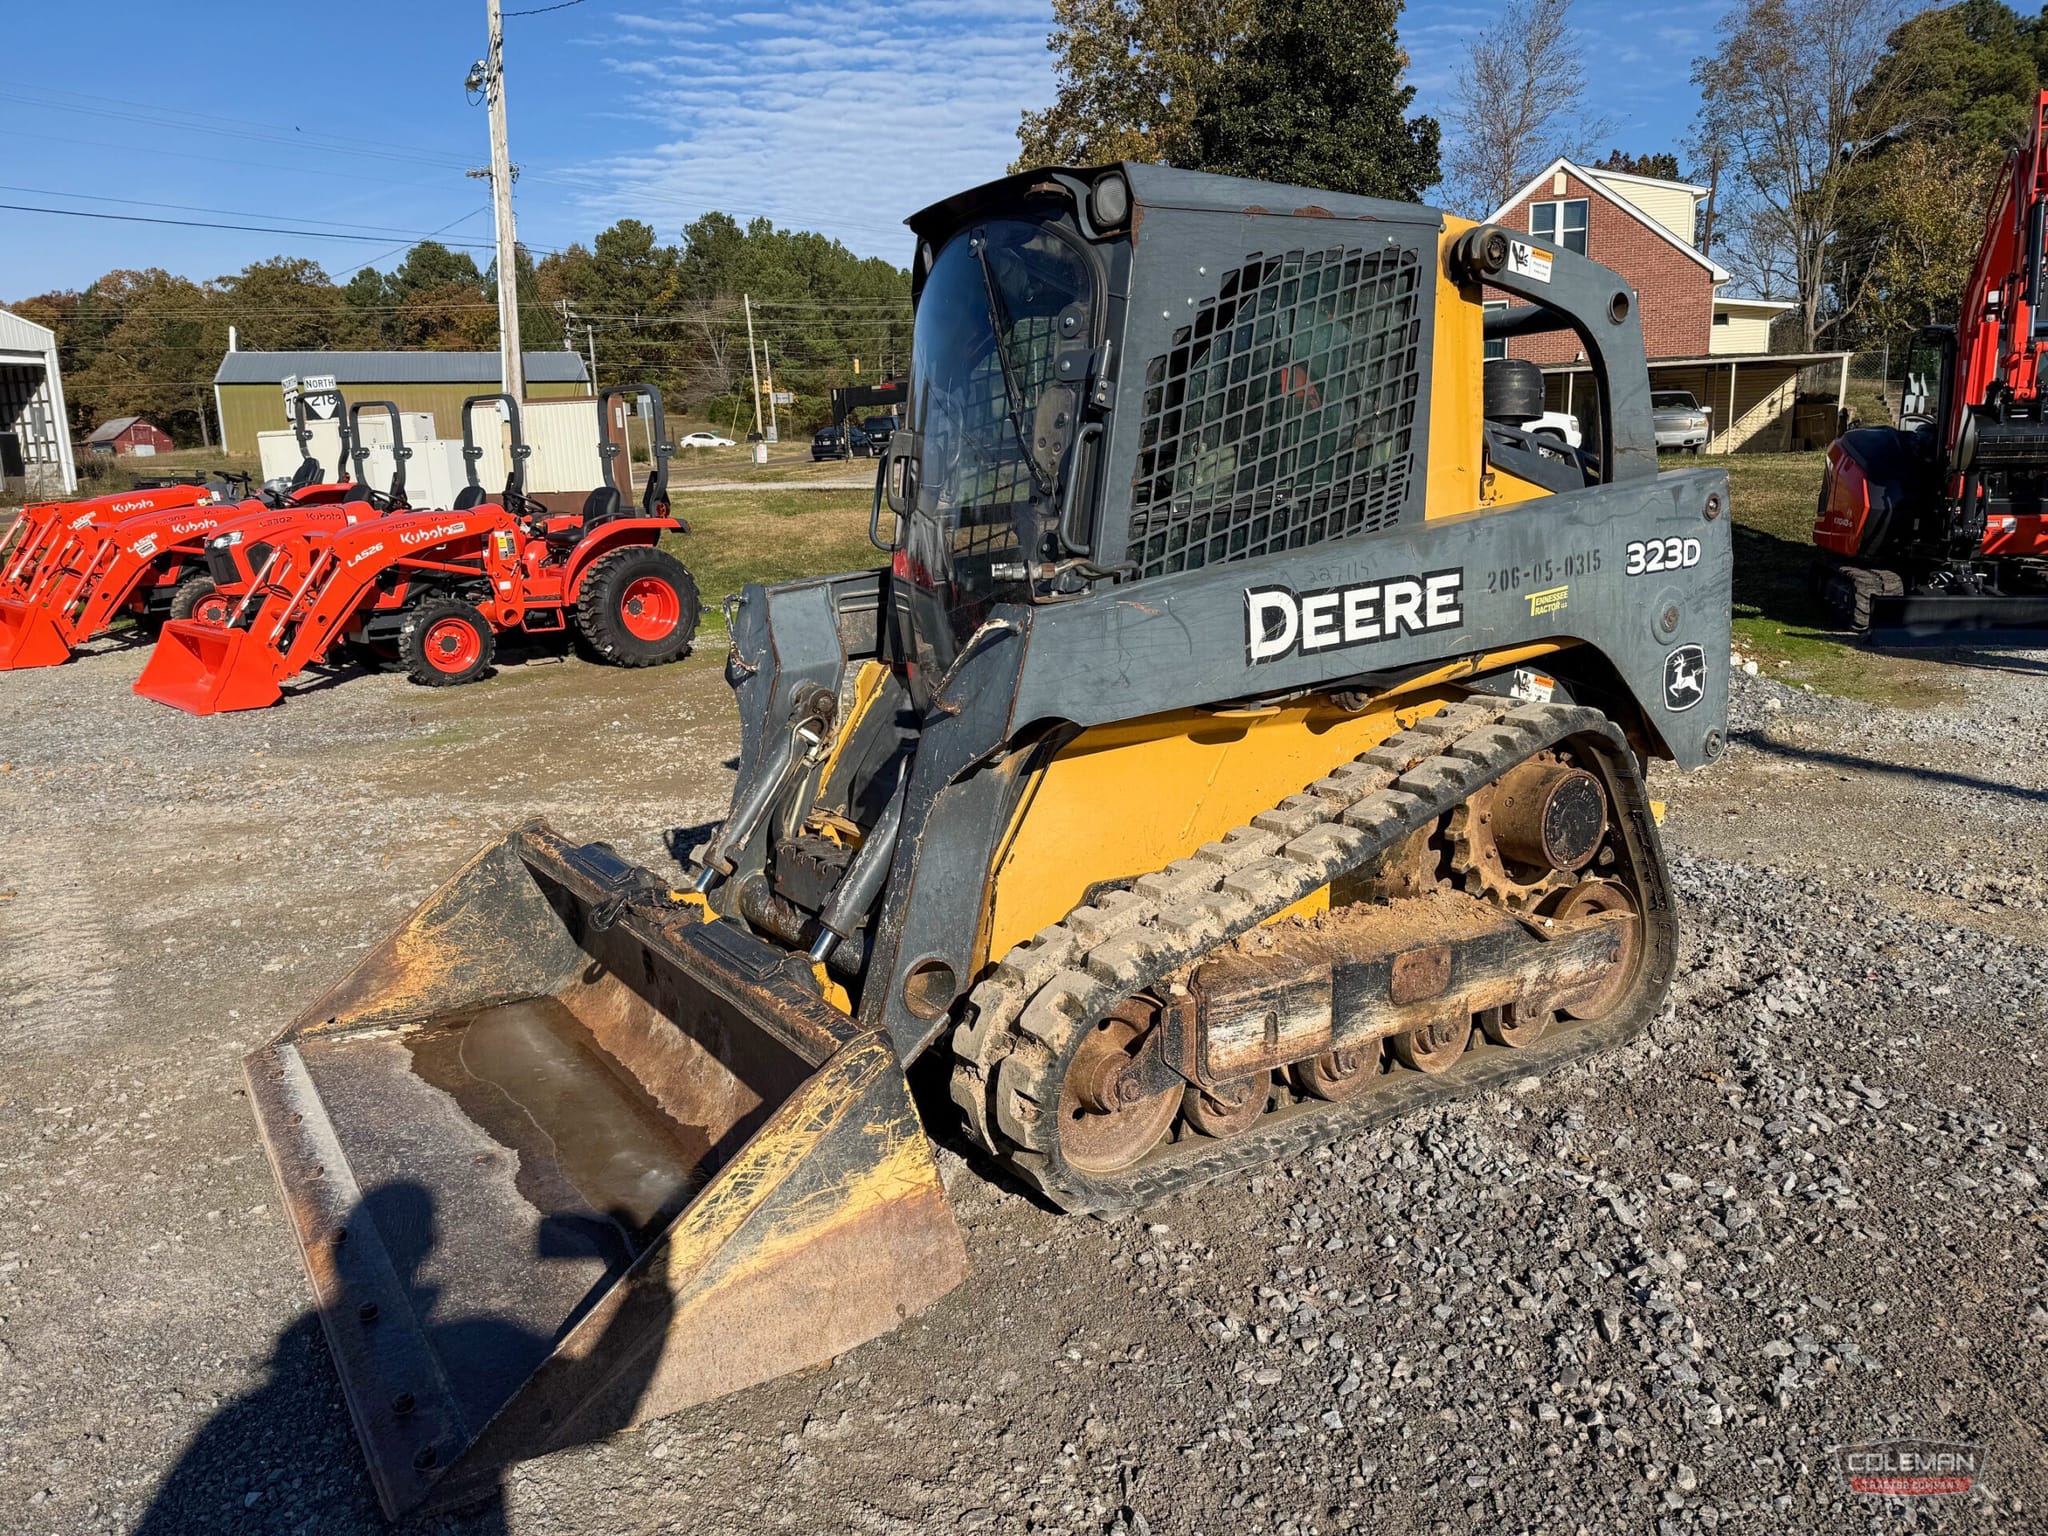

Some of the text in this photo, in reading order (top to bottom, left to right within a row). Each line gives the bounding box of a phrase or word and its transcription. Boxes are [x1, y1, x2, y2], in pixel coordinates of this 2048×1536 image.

[305, 379, 334, 389] NORTH
[311, 395, 337, 406] 218
[112, 499, 154, 513] Kubota
[305, 512, 342, 520] Kubota
[172, 519, 218, 533] Kubota
[400, 525, 451, 544] Kubota
[347, 542, 384, 567] LA526
[1626, 538, 1701, 576] 323D
[1487, 548, 1602, 594] 206-05-0315
[1524, 585, 1569, 606] TENNESSEE
[1246, 571, 1462, 661] DEERE
